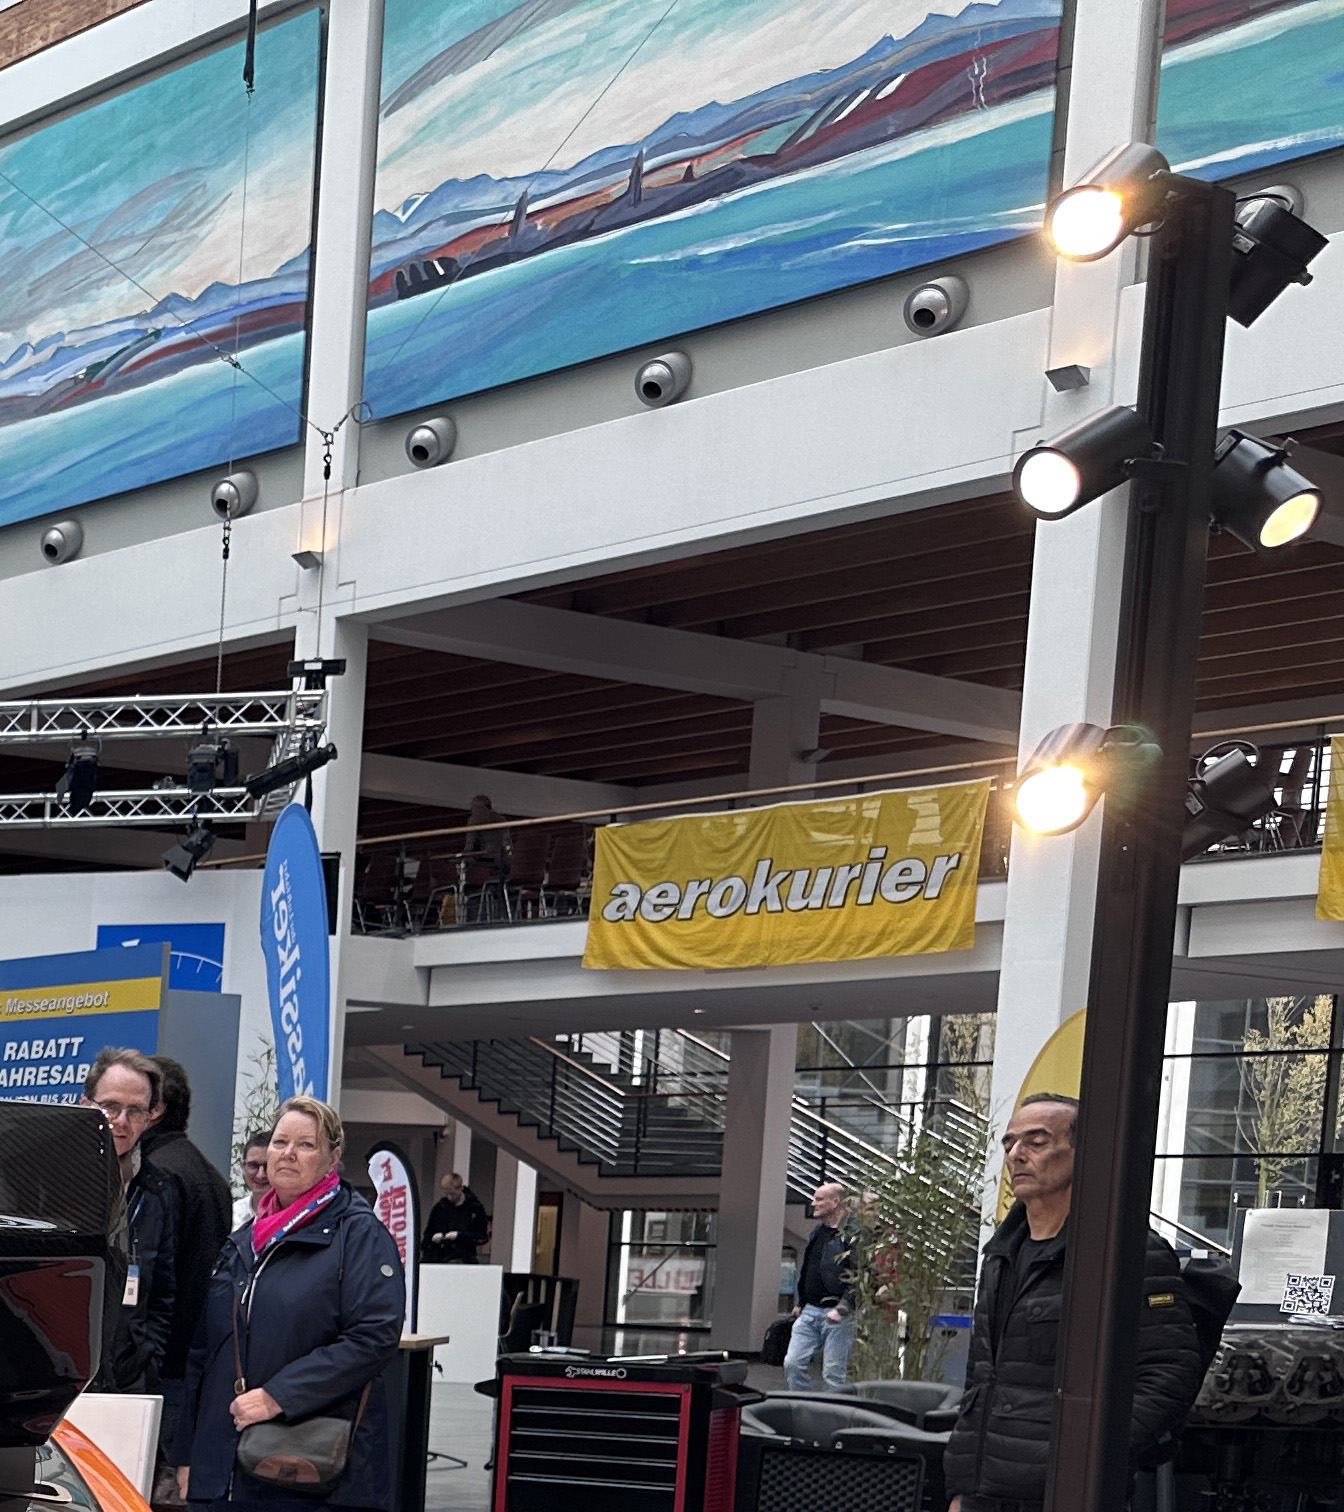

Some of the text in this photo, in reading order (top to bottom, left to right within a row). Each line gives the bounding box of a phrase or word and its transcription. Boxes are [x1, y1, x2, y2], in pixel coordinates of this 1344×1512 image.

[601, 845, 961, 924] aerokurier
[5, 991, 110, 1014] Messeangebot
[3, 1036, 84, 1061] RABATT
